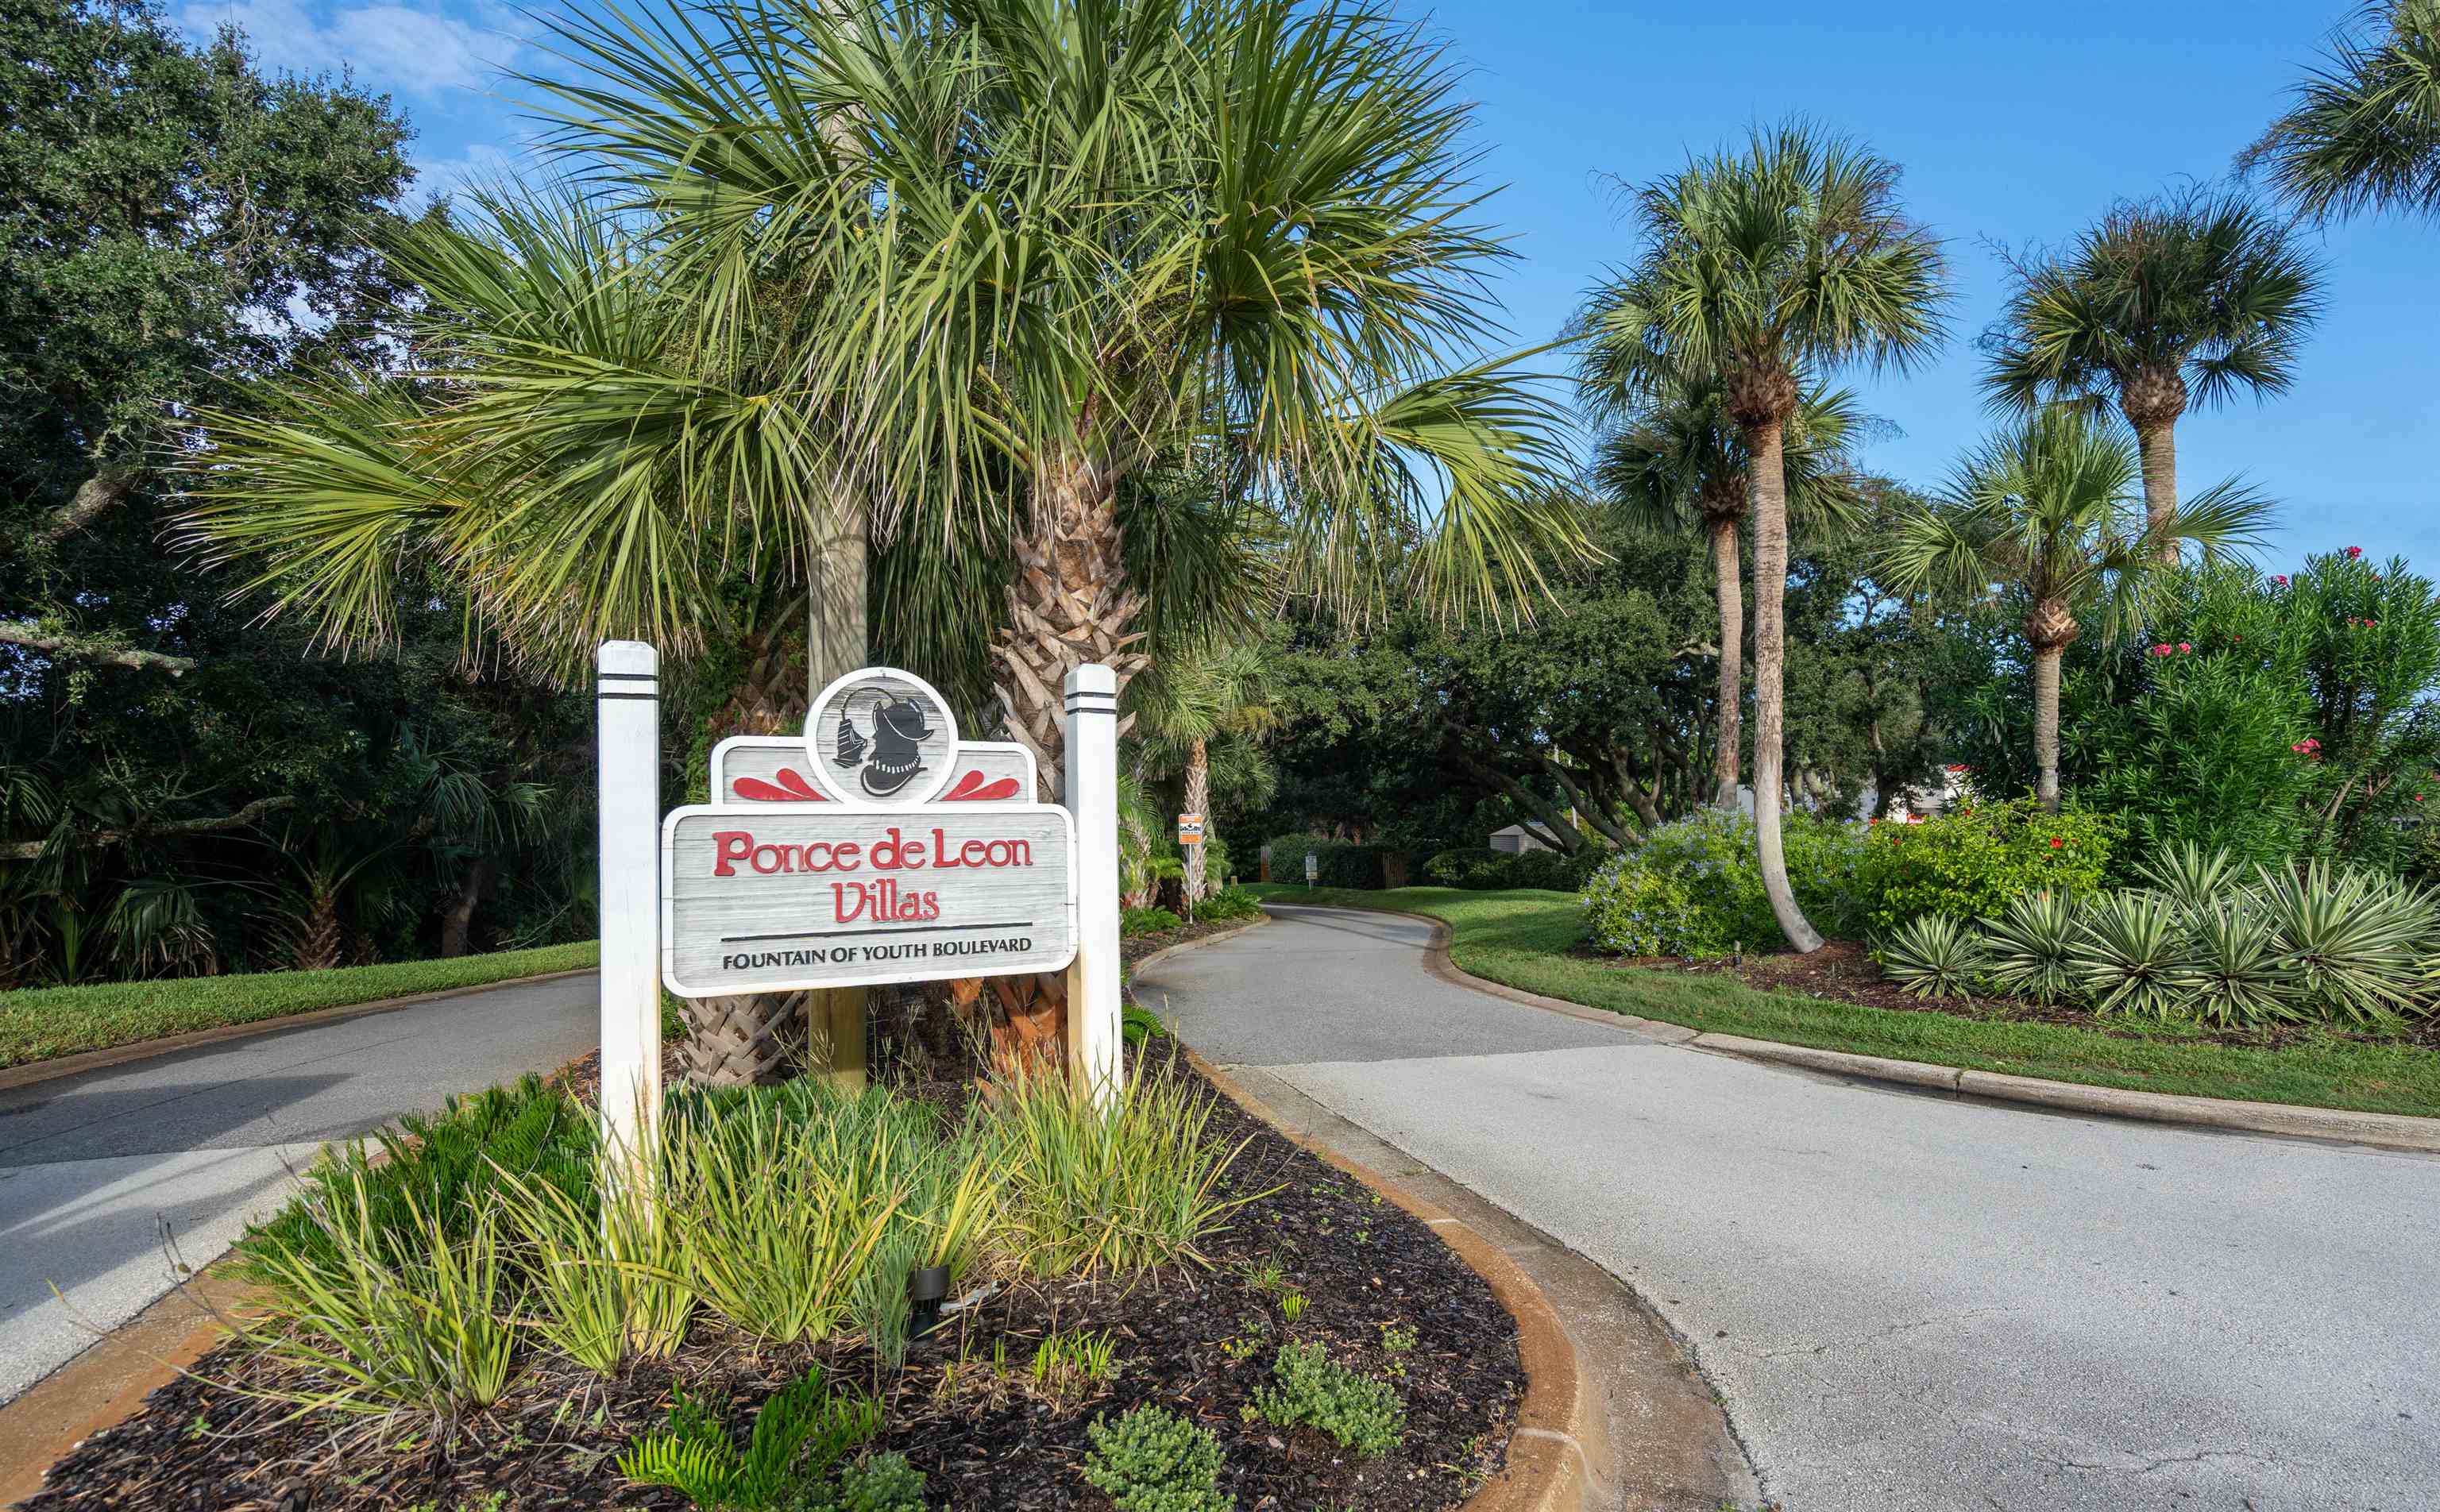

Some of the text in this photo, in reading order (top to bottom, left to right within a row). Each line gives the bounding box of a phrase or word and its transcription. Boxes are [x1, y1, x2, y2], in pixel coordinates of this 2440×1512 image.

[712, 827, 1033, 876] Ponce de Leon
[831, 878, 940, 923] Villas
[723, 937, 1033, 970] FOUNTAIN OF YOUTH BOULEVARD
